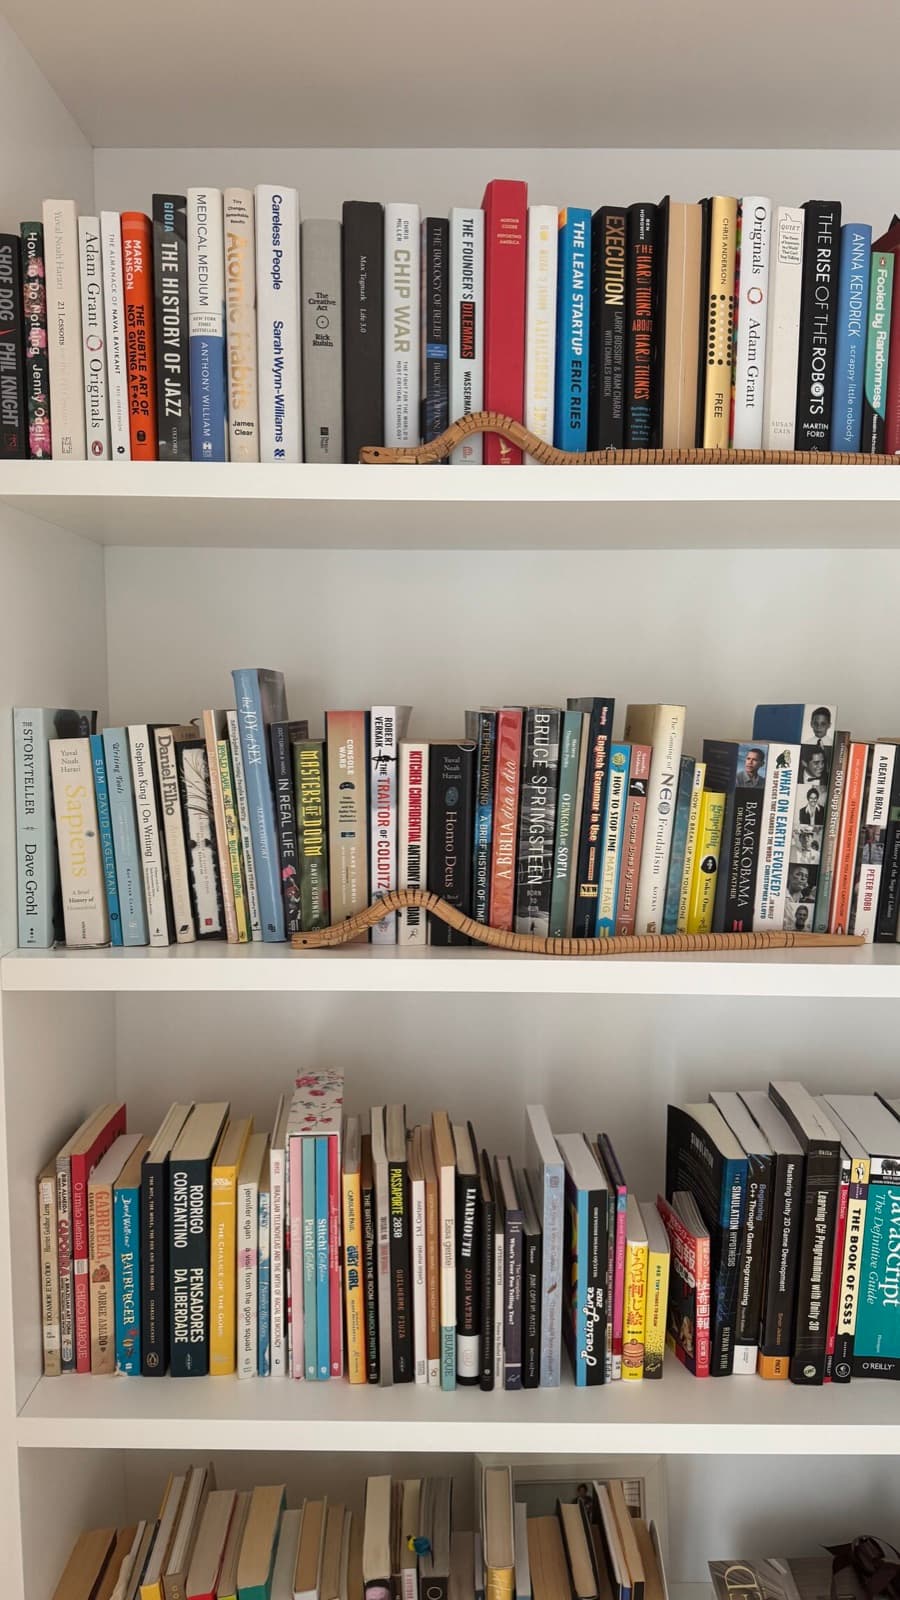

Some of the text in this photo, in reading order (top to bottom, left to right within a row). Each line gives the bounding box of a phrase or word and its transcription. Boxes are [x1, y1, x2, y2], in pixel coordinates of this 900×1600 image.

[133, 240, 143, 272] MARK
[196, 194, 208, 251] MEDICAL
[270, 194, 283, 290] Careless People
[750, 206, 766, 274] Originals
[86, 232, 101, 327] Adam Grant
[125, 240, 134, 290] MANSON
[198, 254, 209, 306] MEDIUM
[358, 273, 367, 301] Tegmark
[432, 227, 442, 340] THE BIOLOGY OF BELIEF
[571, 221, 585, 355] THE LEAN STARTUP
[605, 216, 624, 305] EXECUTION
[847, 233, 864, 337] ANNA KENDRICK
[57, 301, 67, 346] 21 Lessons
[161, 242, 182, 416] THE HISTORY OF JAZZ
[394, 249, 411, 352] CHIP WAR
[1, 343, 18, 426] PHIL KNIGHT
[88, 358, 104, 428] Originals
[136, 305, 149, 416] THE SUBTLE ART OF
[201, 342, 212, 436] ANTHONY WILLIAM
[273, 320, 286, 442] Sarah Wynn-Williams
[463, 371, 472, 416] WASSERMAN
[570, 360, 582, 429] ERIC RIES
[745, 319, 760, 408] Adam Grant
[714, 393, 724, 418] FREE
[374, 716, 384, 748] VERKAIK
[384, 717, 393, 746] ROBERT
[599, 707, 608, 725] Murphy
[23, 729, 35, 815] STORYTELLER
[135, 743, 148, 799] Stephen King
[158, 735, 175, 816] Daniel Filho
[346, 739, 354, 775] CONSOLE
[480, 720, 491, 804] STEPHEN HAWKING
[877, 763, 887, 785] DEATH
[60, 784, 92, 878] Sapiens
[142, 810, 152, 823] On
[278, 779, 295, 858] IN REAL LIFE
[408, 751, 422, 843] KITCHEN CONFIDENTIAL
[527, 714, 550, 884] BRUCE SPRINGSTEEN
[872, 796, 884, 821] BRAZIL
[143, 825, 154, 857] Writing
[444, 811, 457, 888] Homo Deus
[479, 824, 488, 849] BRIEF
[729, 807, 743, 899] DREAMS FROM MY FATHER
[736, 801, 757, 907] BARACK OBAMA
[770, 770, 792, 897] WHAT ON EARTH EVOLVED?
[24, 844, 38, 915] Dave Grohl
[477, 851, 487, 887] HISTORY
[477, 889, 486, 901] OF
[703, 877, 711, 895] Yoko
[863, 868, 875, 911] PETER ROBB
[476, 903, 486, 922] TIME
[95, 1191, 111, 1265] GABRIELA,
[173, 1172, 188, 1248] CONSTANTINO
[190, 1185, 204, 1234] RODRIGO
[244, 1188, 253, 1218] jennifer
[304, 1219, 315, 1250] Patch!
[317, 1218, 327, 1250] Stitch!
[391, 1168, 403, 1238] PASSAPORTE 2030
[461, 1188, 476, 1257] LIARMOUTH
[756, 1184, 766, 1220] Beginning
[778, 1164, 795, 1291] Mastering Unity 2D Game Development
[443, 1219, 453, 1266] Essa gente
[741, 1183, 757, 1306] C++ Through Game Programming
[808, 1191, 829, 1331] Learning C# Programming with Unity 3D
[843, 1208, 861, 1325] THE BOOK OF CSS3
[866, 1193, 886, 1304] The Definitive Guide
[878, 1190, 900, 1307] JavaScript
[121, 1253, 135, 1325] RATBURGER
[174, 1269, 187, 1343] DA LIBERDADE
[190, 1268, 204, 1343] PENSADORES
[348, 1269, 359, 1290] GIRL
[464, 1268, 473, 1329] JOHN WATERS
[77, 1284, 87, 1358] CHICO BUARQUE
[97, 1290, 108, 1346] JORGE AMADO
[720, 1327, 731, 1369] RIZWAN VIRK
[444, 1334, 454, 1377] BUARQUE
